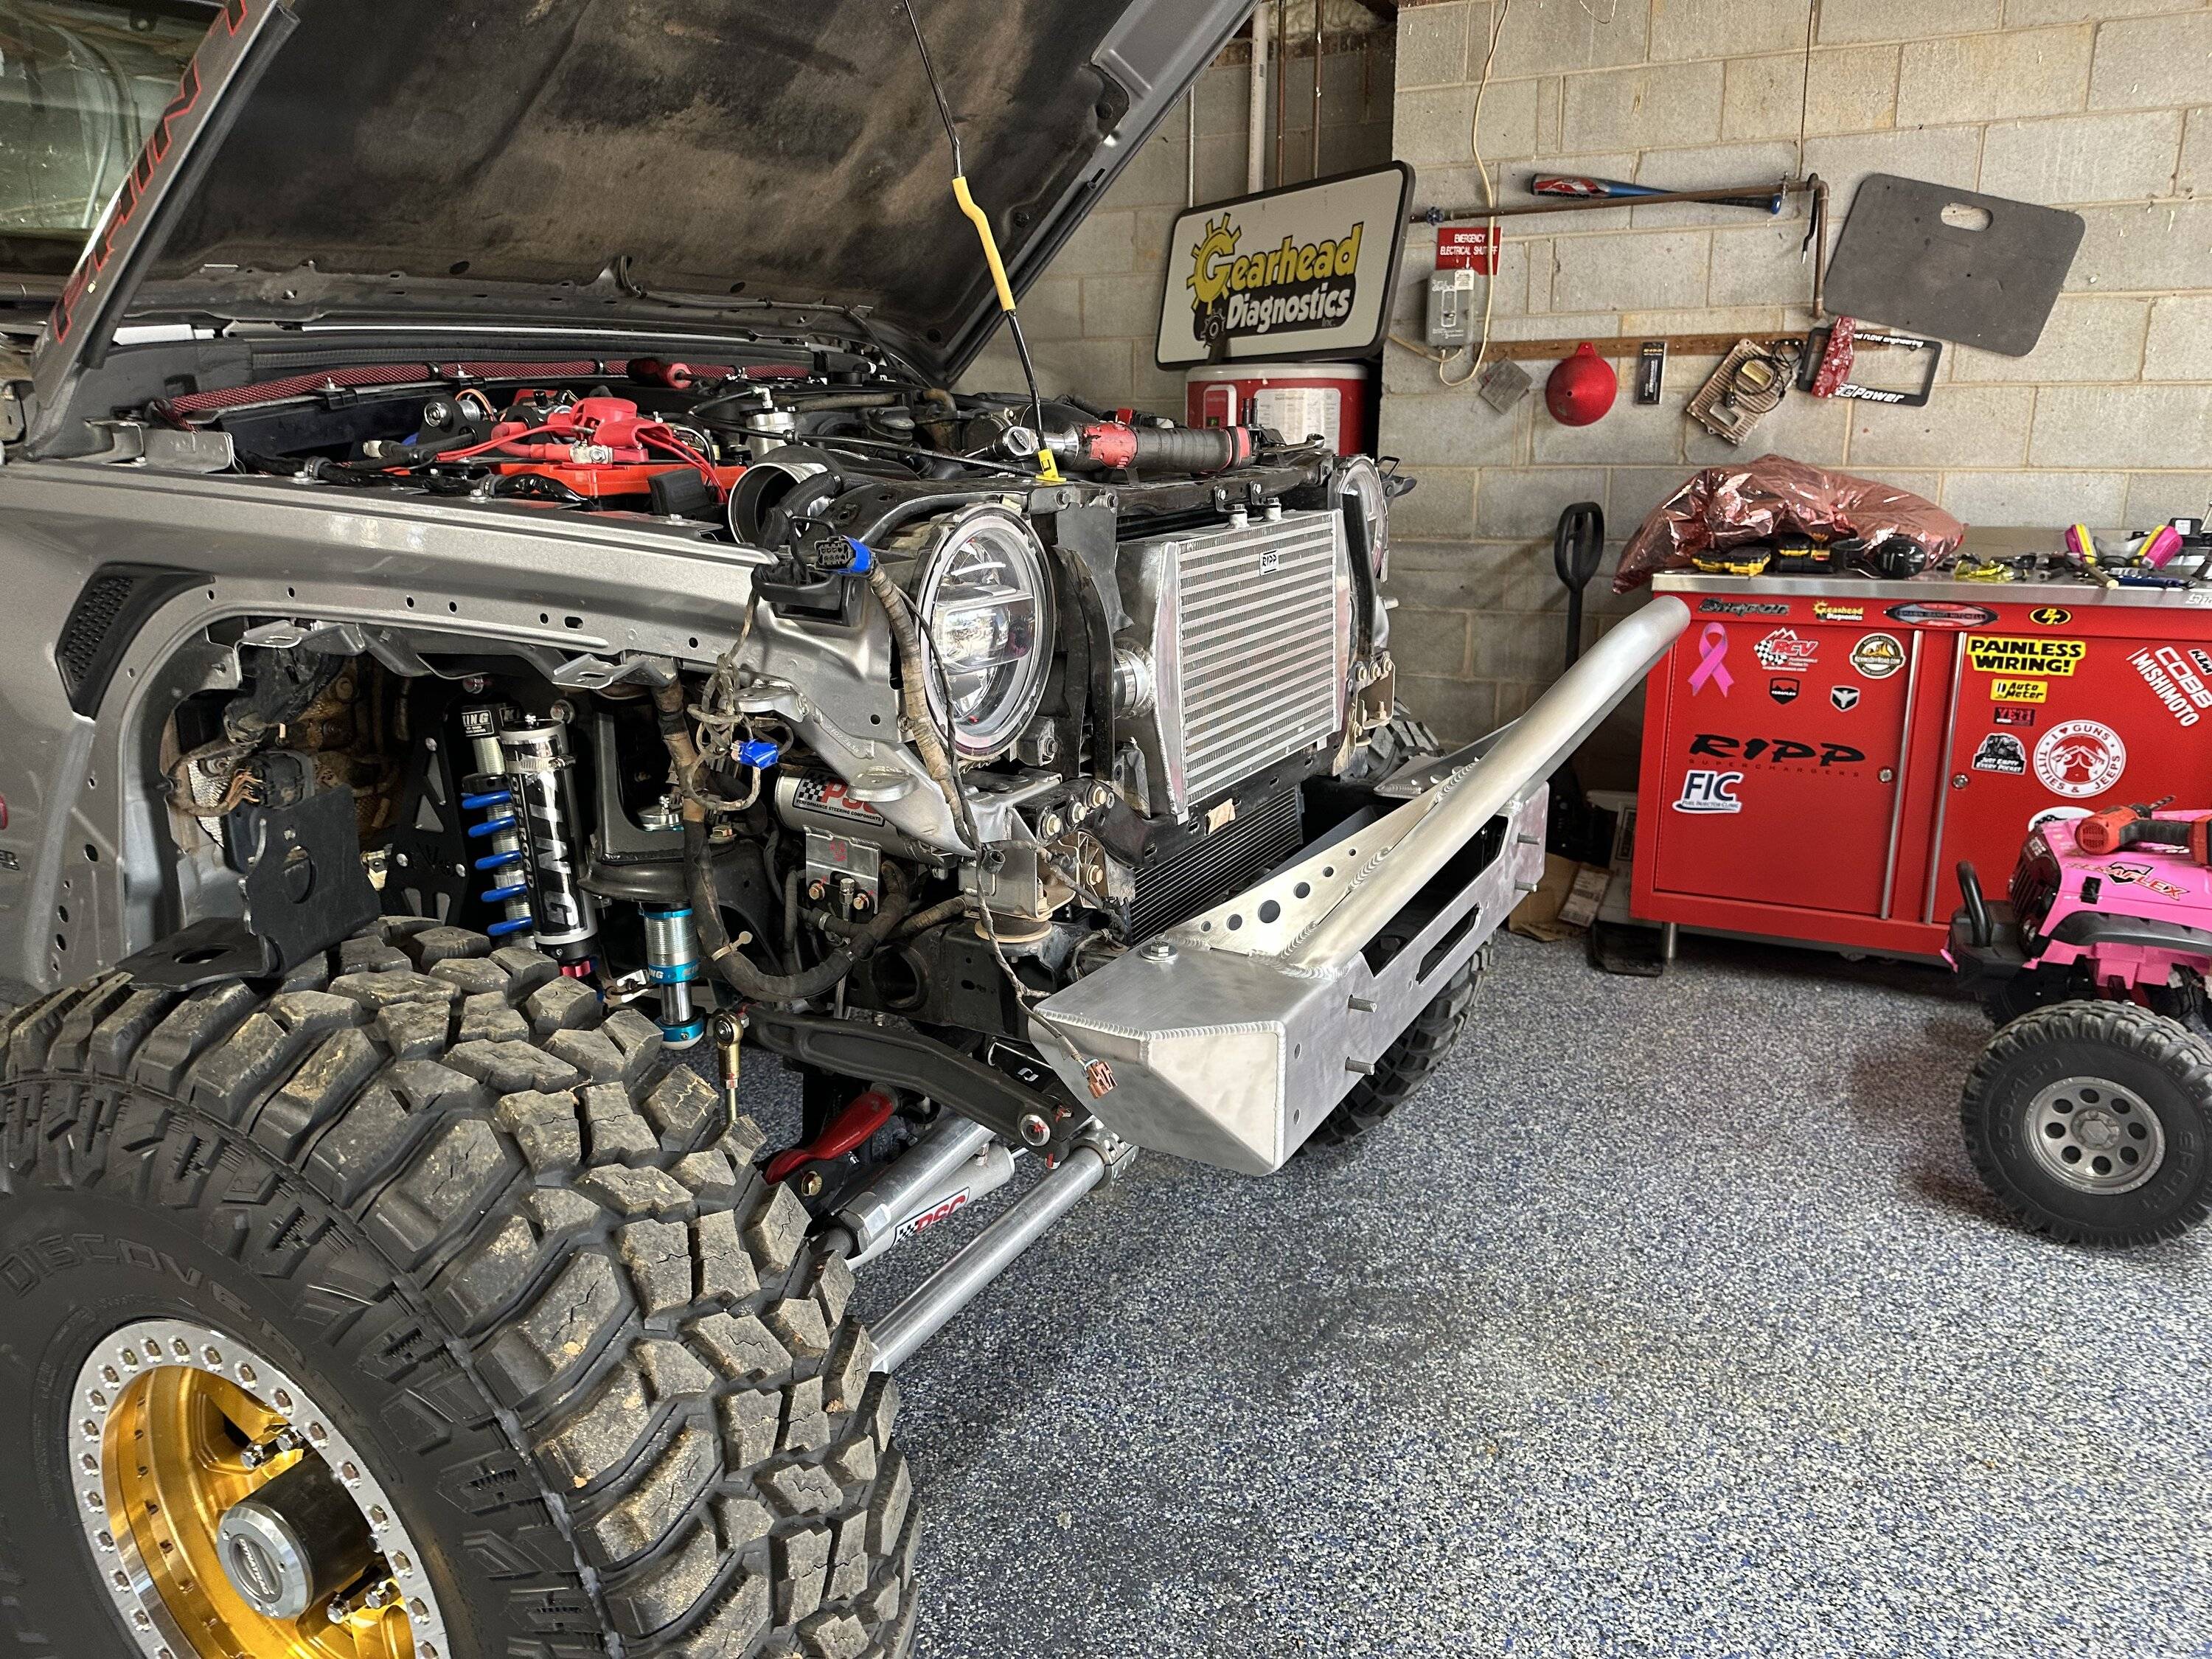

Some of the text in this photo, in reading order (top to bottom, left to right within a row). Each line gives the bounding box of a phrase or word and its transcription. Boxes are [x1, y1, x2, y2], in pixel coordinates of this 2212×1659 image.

[1454, 234, 1486, 243] EMERGENCY
[1188, 215, 1364, 305] Gearhead
[1440, 246, 1498, 256] ELECTRICAL SHUTFF
[1225, 282, 1351, 333] Diagnostics
[1262, 554, 1277, 566] RIPP
[1813, 601, 1864, 615] Gearhead
[1771, 639, 1818, 656] RCV
[1970, 639, 2081, 658] PAINLESS
[1975, 655, 2070, 672] WIRING!
[2009, 682, 2039, 691] Auto
[2154, 646, 2212, 709] COBB
[2005, 690, 2044, 699] Meter
[2132, 652, 2200, 727] MISHIMOTO
[2073, 723, 2110, 741] GUNS
[1688, 734, 1865, 767] RIPP
[1688, 759, 1859, 777] SUPERCHARGERS
[2038, 751, 2065, 790] TITTIES
[2093, 754, 2121, 790] JEEPS
[1683, 773, 1741, 801] FIC
[796, 799, 881, 821] PERFORMANCE STEERING COMPONENTS
